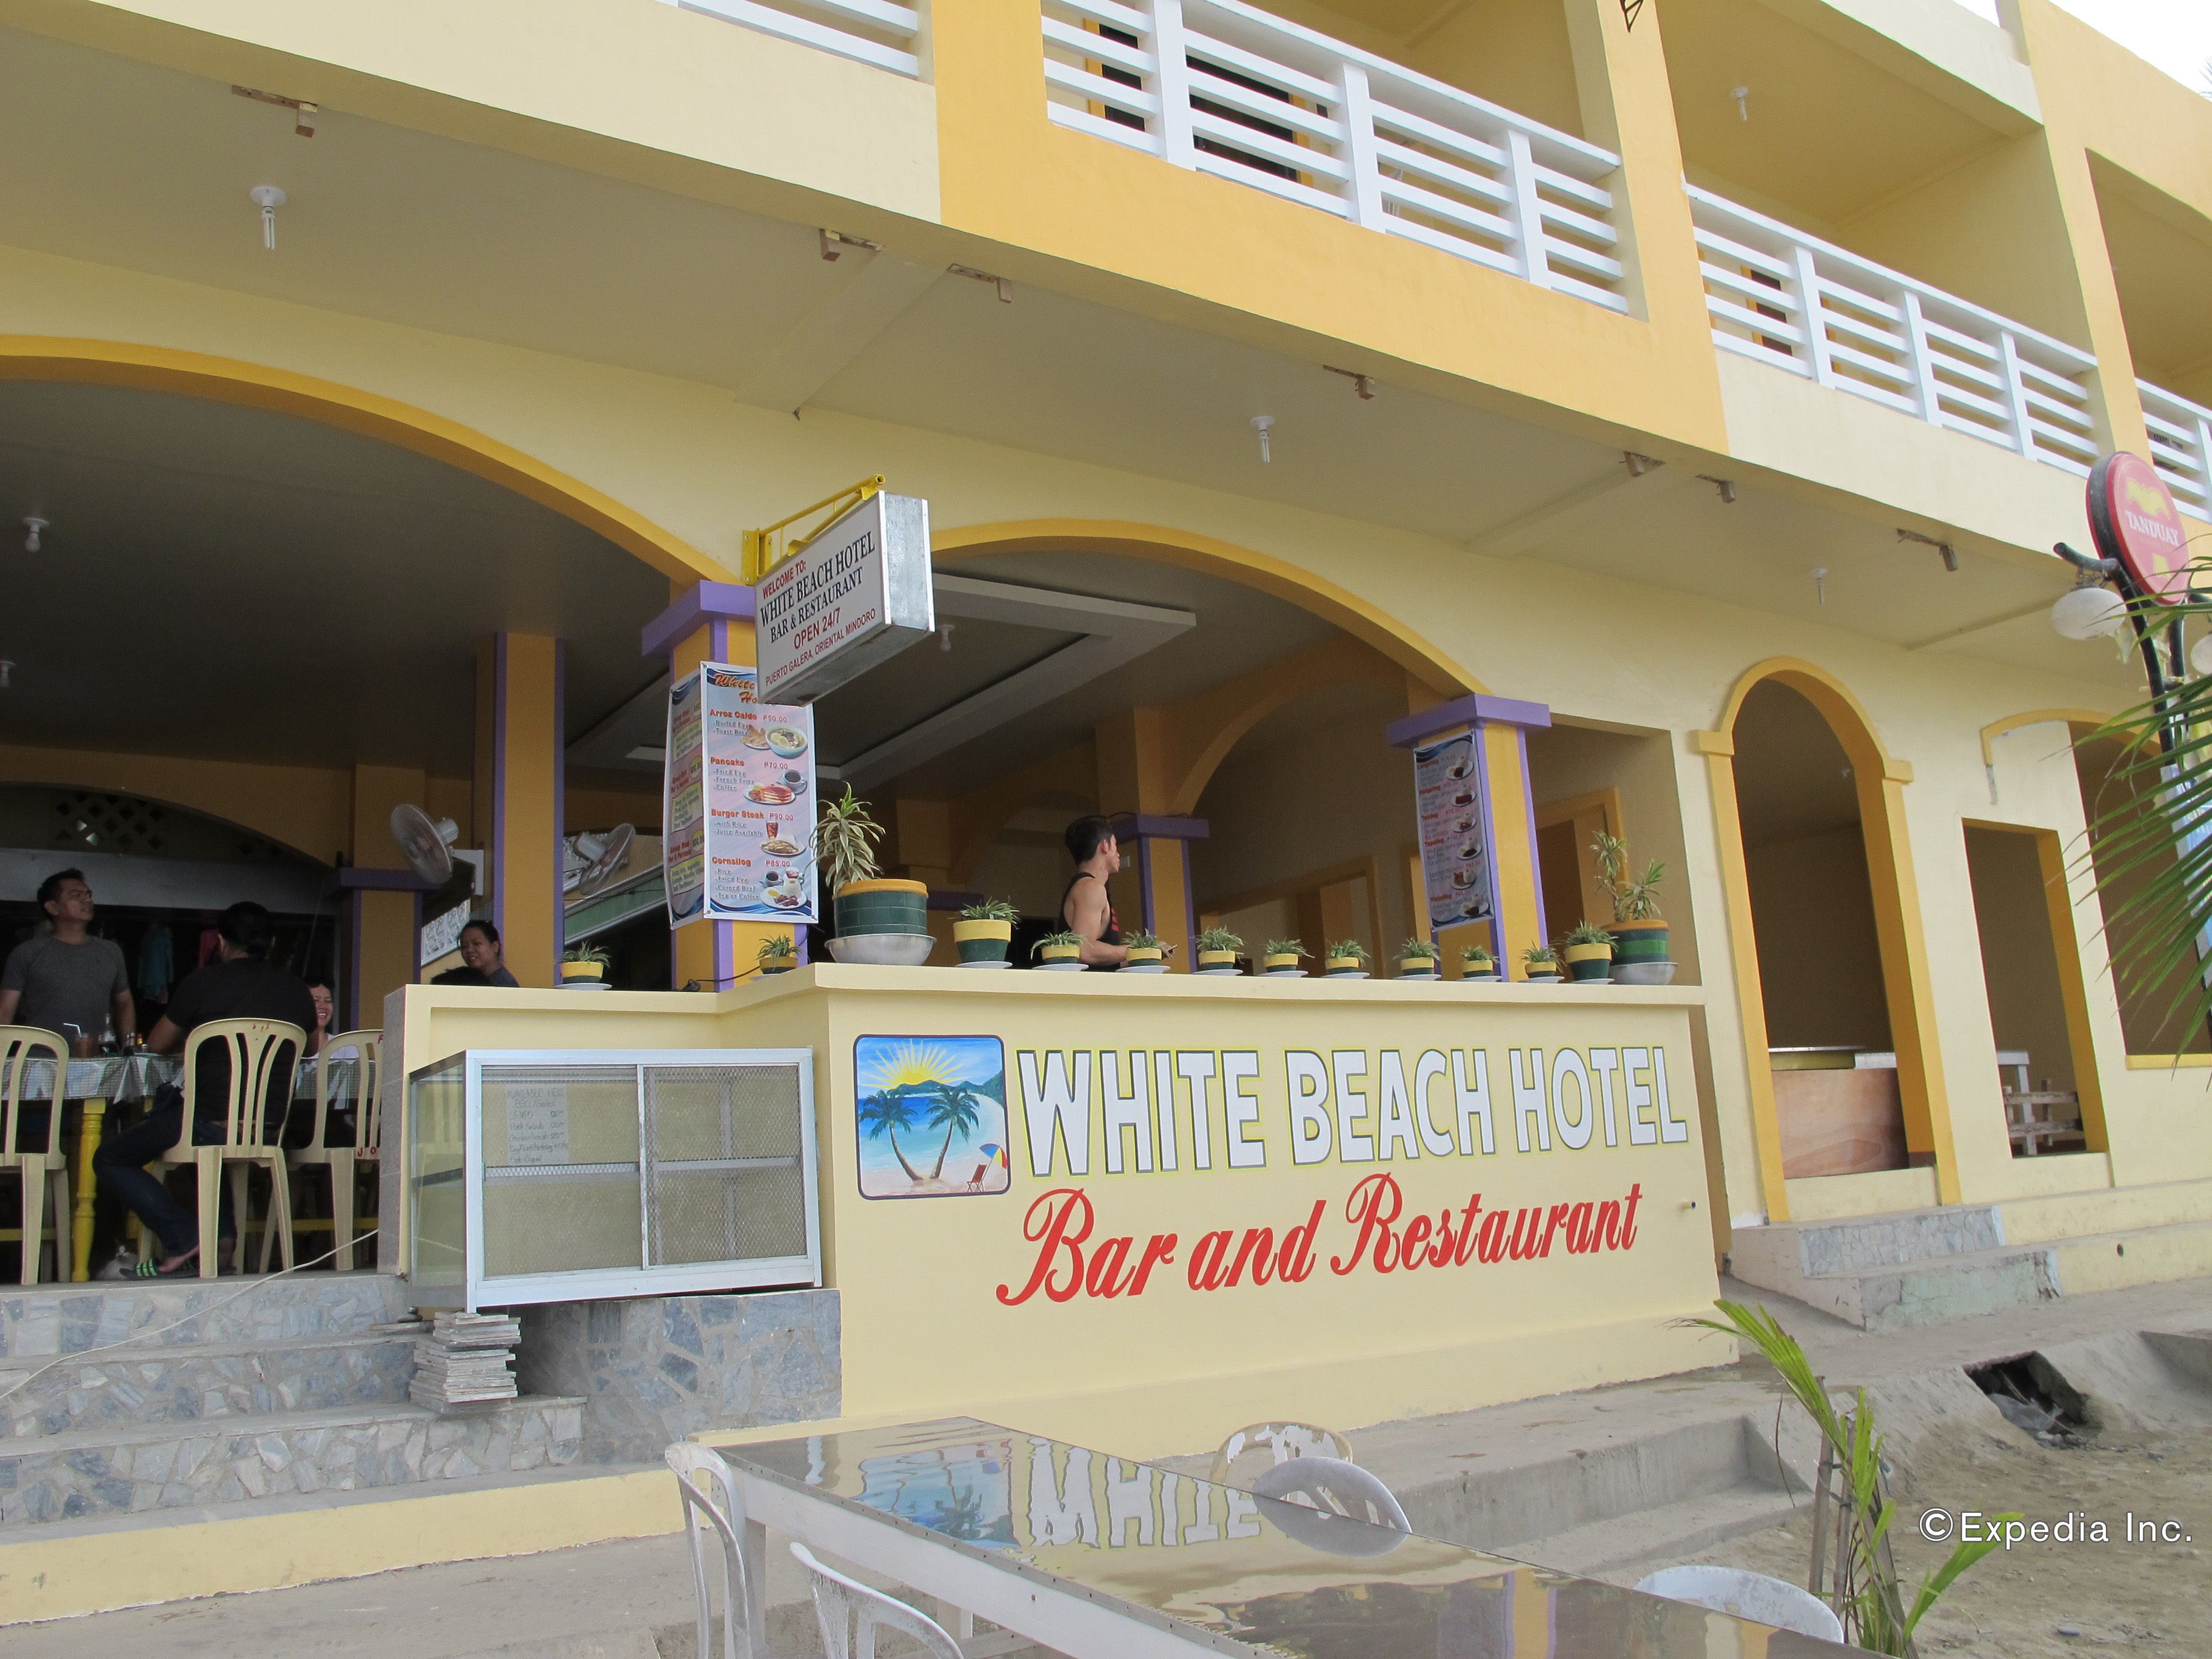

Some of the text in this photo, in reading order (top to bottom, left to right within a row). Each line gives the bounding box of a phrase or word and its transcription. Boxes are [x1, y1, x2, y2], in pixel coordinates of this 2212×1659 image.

[2125, 511, 2179, 546] TANDUAY
[760, 531, 875, 627] WHITE BEACH HOTEL
[762, 560, 806, 600] WELCOME TO:
[771, 566, 863, 643] BAR & RESTAURANT
[766, 662, 788, 687] PUERTO
[815, 631, 843, 655] ORIENTAL
[845, 608, 876, 636] MINDORO
[794, 607, 840, 649] OPEN 24/7
[715, 674, 755, 689] White
[710, 757, 745, 766] Pancake
[711, 808, 739, 819] Burger
[742, 810, 764, 819] Steak
[712, 856, 751, 867] Cornsilog
[1016, 1046, 1689, 1178] WHITE BEACH HOTEL
[996, 1172, 1643, 1306] Bar and Restaurant
